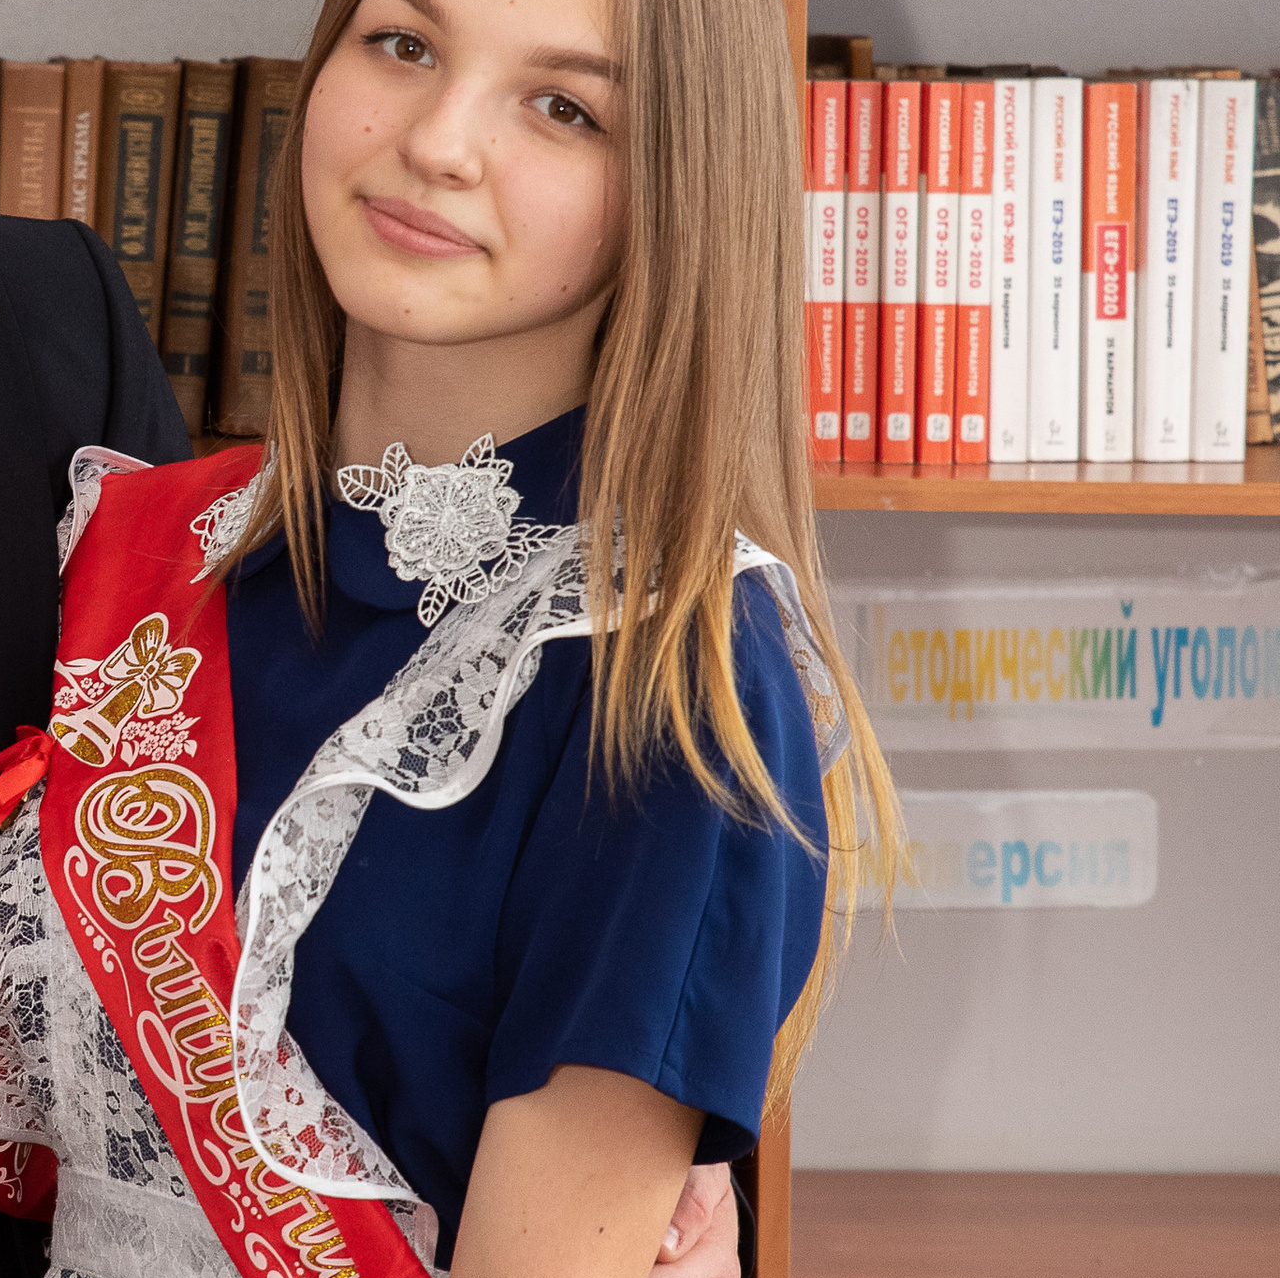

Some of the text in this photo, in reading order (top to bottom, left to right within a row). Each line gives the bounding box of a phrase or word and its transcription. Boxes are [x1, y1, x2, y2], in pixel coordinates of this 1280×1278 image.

[1004, 86, 1018, 151] РУССКИЙ
[1054, 95, 1065, 148] РУССКИЙ
[1106, 102, 1120, 172] РУССКИЙ
[1170, 94, 1180, 148] РУССКИЙ
[1225, 98, 1237, 151] РУССКИЙ
[822, 206, 836, 286] ОГЭ-2020
[856, 206, 869, 287] ОГЭ-2020
[894, 206, 908, 287] ОГЭ-2020
[936, 208, 949, 288] ОГЭ-2020
[970, 209, 982, 289] ОГЭ-2020
[1004, 202, 1014, 264] ОГЭ-2018
[1052, 200, 1064, 266] ЕГЭ-2019
[1166, 198, 1178, 264] ЕГЭ-2019
[1220, 202, 1234, 267] ЕГЭ-2019
[1103, 230, 1120, 316] ЕГЭ-2020
